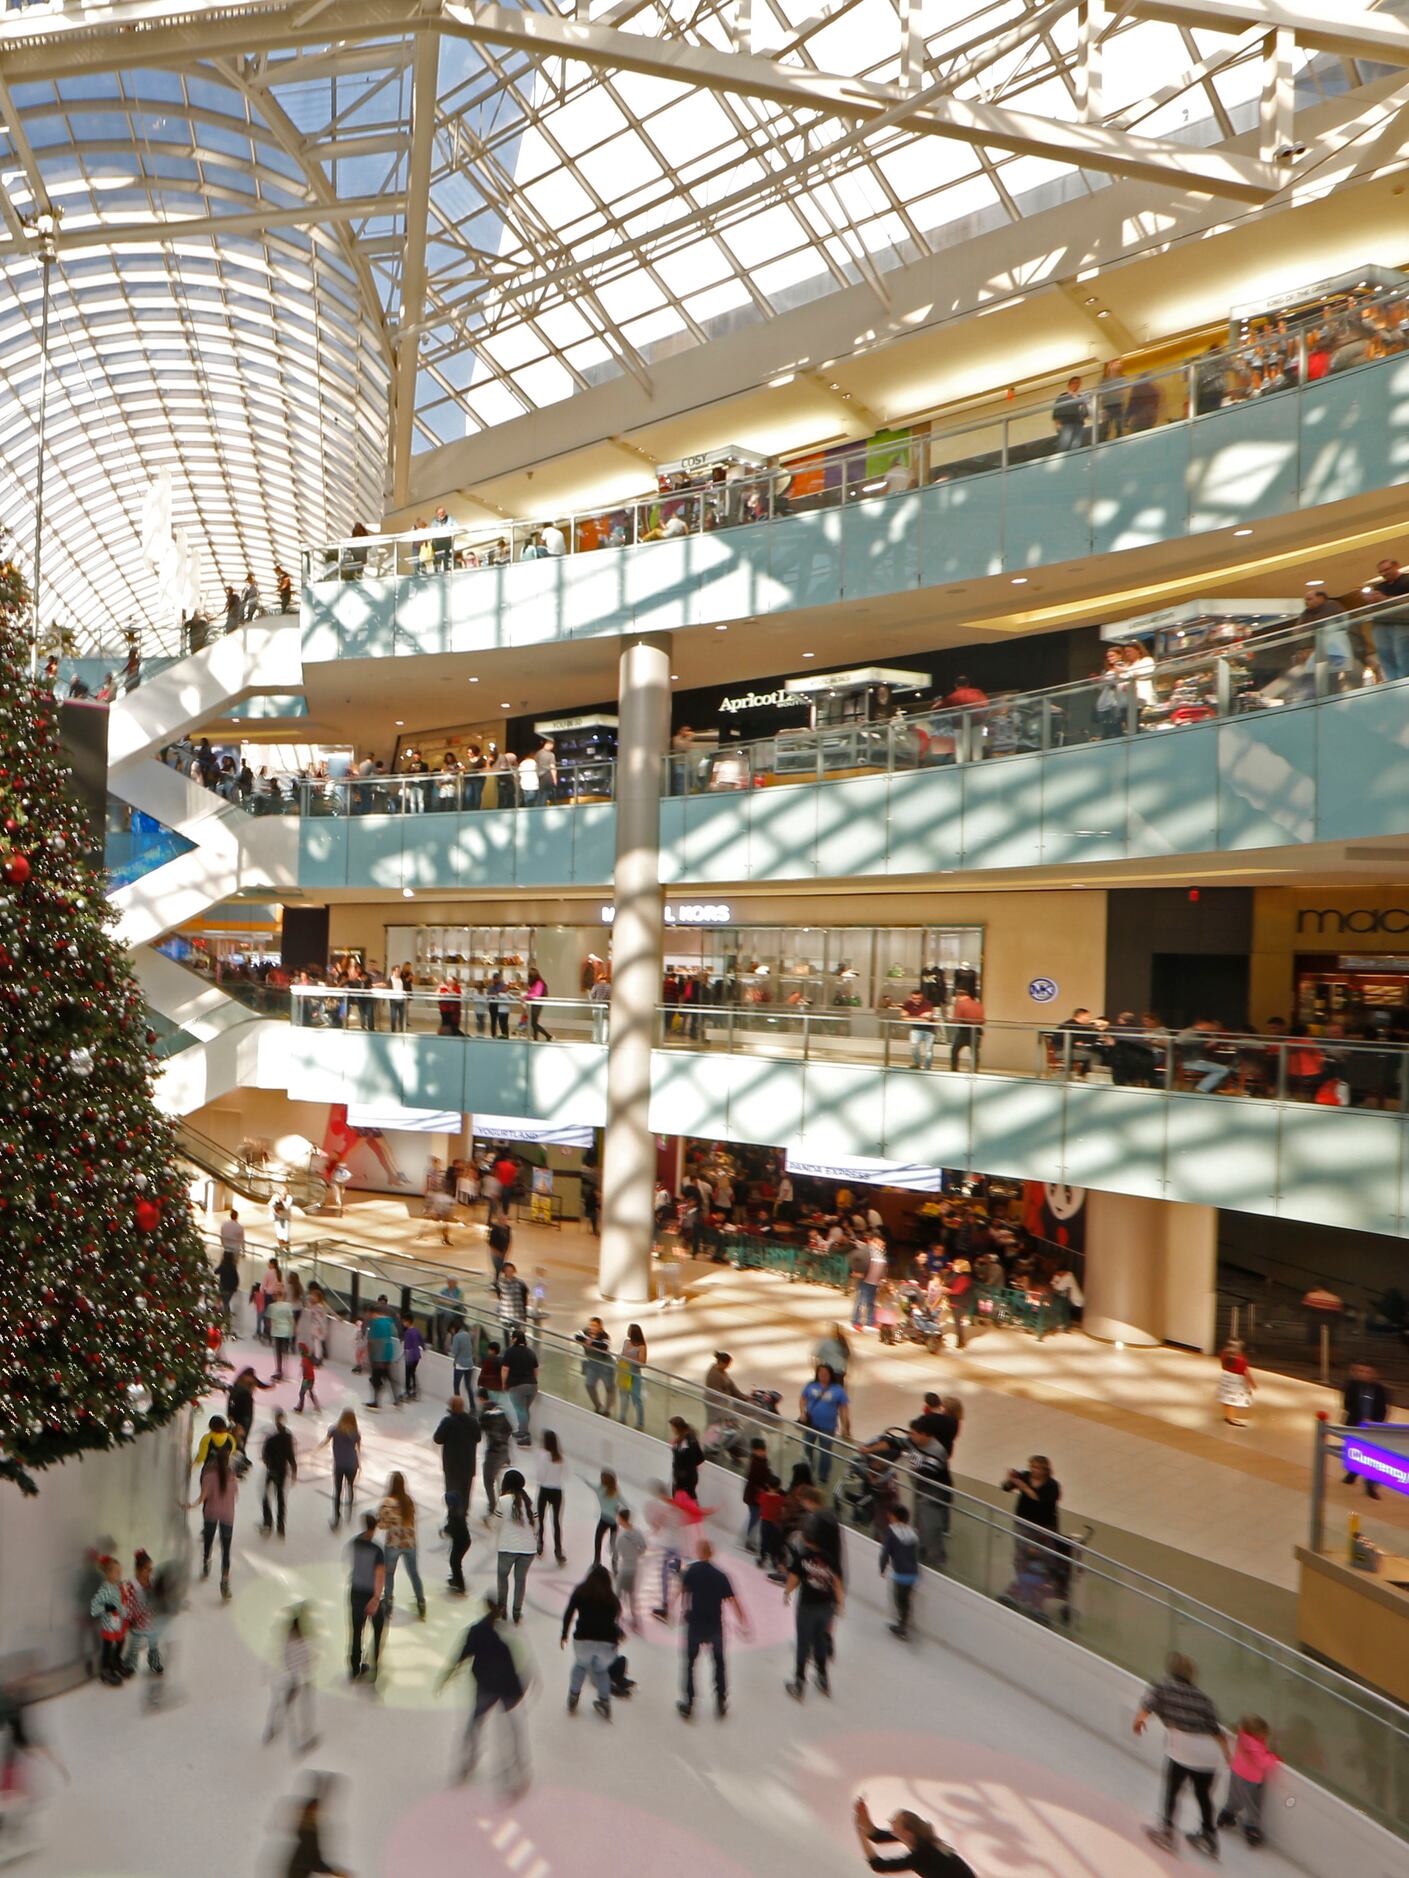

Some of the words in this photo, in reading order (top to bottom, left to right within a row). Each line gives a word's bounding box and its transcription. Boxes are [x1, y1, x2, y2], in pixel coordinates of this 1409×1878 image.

[681, 453, 707, 468] COSY
[718, 691, 778, 713] Apricot
[679, 905, 731, 922] KORS
[790, 1162, 822, 1174] PANDA
